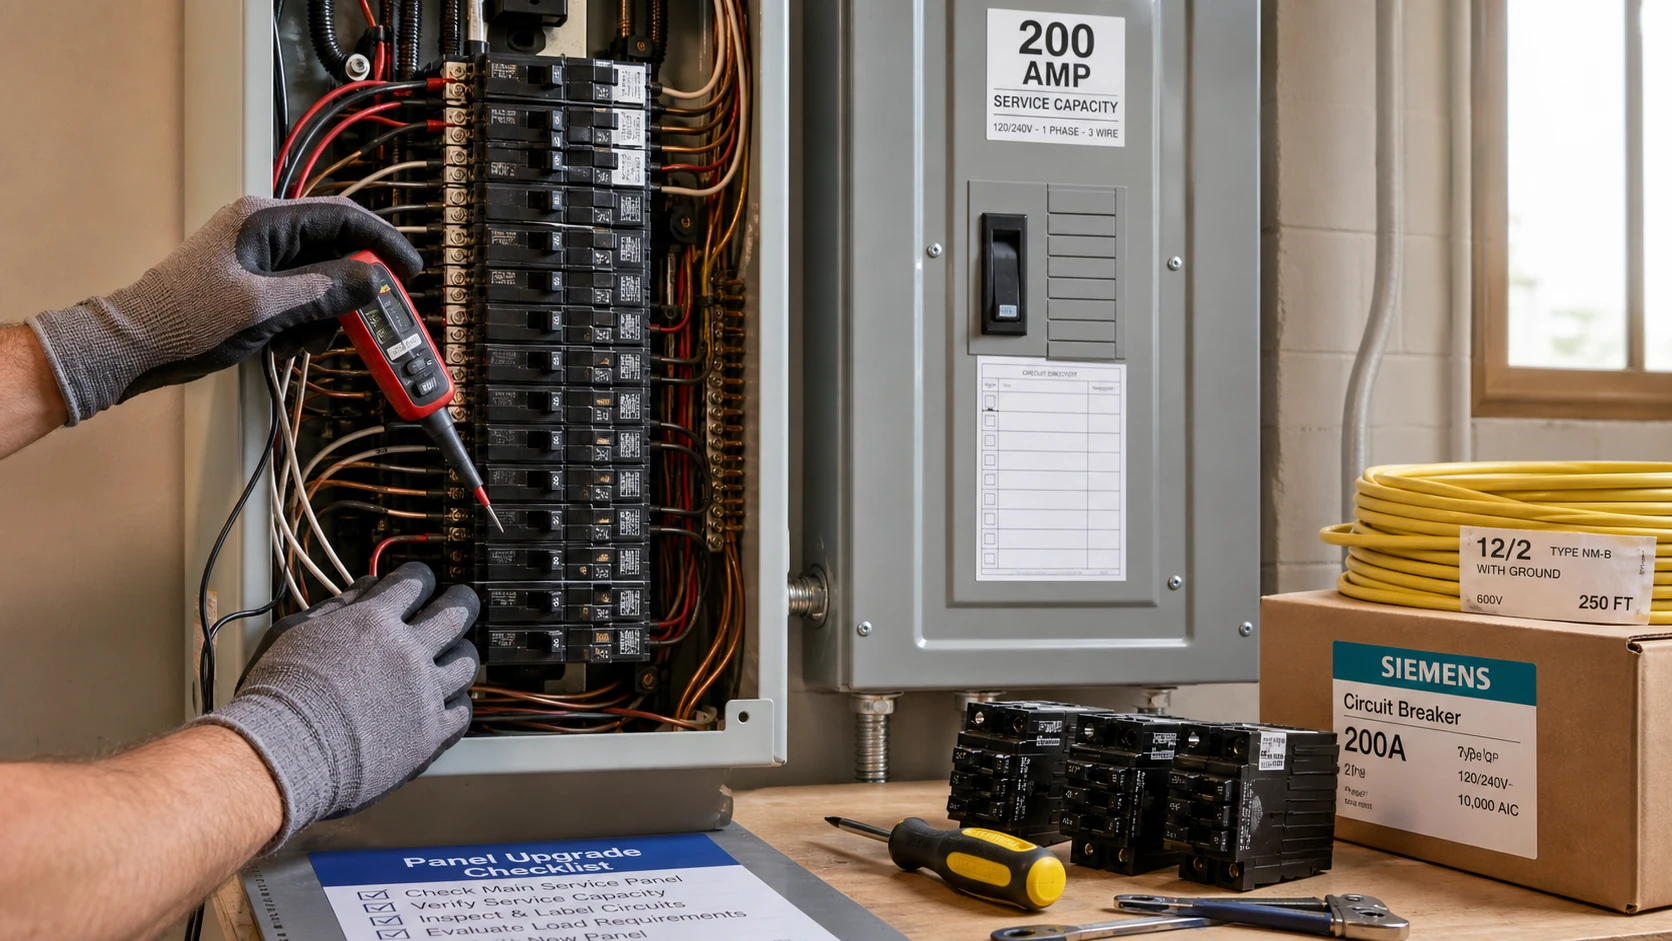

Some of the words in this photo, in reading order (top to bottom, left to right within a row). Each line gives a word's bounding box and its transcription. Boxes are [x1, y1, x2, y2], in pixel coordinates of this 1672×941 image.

[1018, 20, 1095, 58] 200
[1022, 60, 1091, 88] AMP
[994, 94, 1050, 110] SERVICE
[1054, 98, 1118, 114] CAPACITY
[993, 122, 1033, 134] 120/240V
[1042, 126, 1046, 134] 1
[1049, 125, 1079, 136] PHASE
[1088, 128, 1094, 137] 3
[1096, 128, 1119, 139] WIRE
[1477, 537, 1532, 561] 12/2
[1550, 546, 1579, 558] TYPE
[1582, 548, 1612, 559] NM-B
[1476, 563, 1506, 576] WITH
[1509, 566, 1561, 579] GROUND
[1476, 594, 1503, 605] 600V
[1578, 594, 1609, 610] 250
[1613, 596, 1633, 611] FT
[1381, 655, 1491, 691] SIEMENS
[1343, 692, 1393, 716] Circuit
[1398, 700, 1462, 725] Breaker
[1344, 726, 1407, 762] 200A
[1458, 793, 1495, 812] 10,000
[1498, 801, 1520, 817] AIC
[403, 853, 498, 868] Panel
[505, 847, 642, 865] Upgrade
[463, 861, 614, 878] Checklist
[405, 886, 476, 898] Check
[482, 884, 535, 894] Main
[541, 879, 619, 891] Service
[624, 875, 683, 887] Panel
[410, 899, 476, 911] Verify
[483, 895, 566, 907] Service
[572, 889, 666, 902] Capacity
[419, 910, 502, 924] Inspect
[511, 909, 529, 918] &
[534, 905, 595, 917] Label
[601, 900, 686, 914] Circuits
[425, 924, 525, 937] Evaluate
[531, 919, 588, 931] Load
[594, 910, 747, 927] Requirements
[583, 930, 648, 941] Panel
